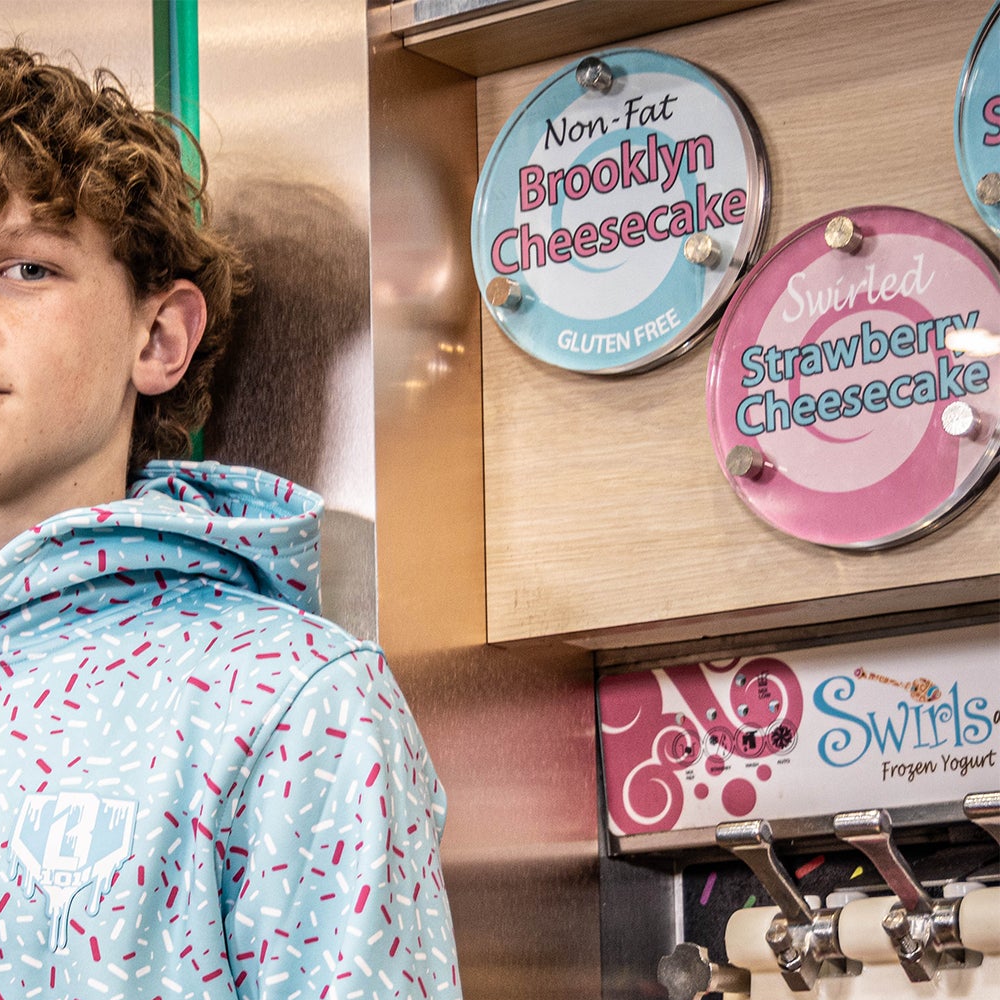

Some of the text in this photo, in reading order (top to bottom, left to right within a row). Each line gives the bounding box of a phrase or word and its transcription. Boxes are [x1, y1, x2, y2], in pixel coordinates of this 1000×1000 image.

[543, 93, 678, 150] Non-Fat
[518, 133, 714, 212] Brooklyn
[490, 183, 747, 275] Cheesecake
[782, 252, 936, 323] Swirled
[557, 307, 682, 355] GLUTEN FREE
[735, 355, 990, 437] Cheesecake
[813, 675, 992, 767] Swirls
[882, 749, 997, 782] Frozen Yogurt
